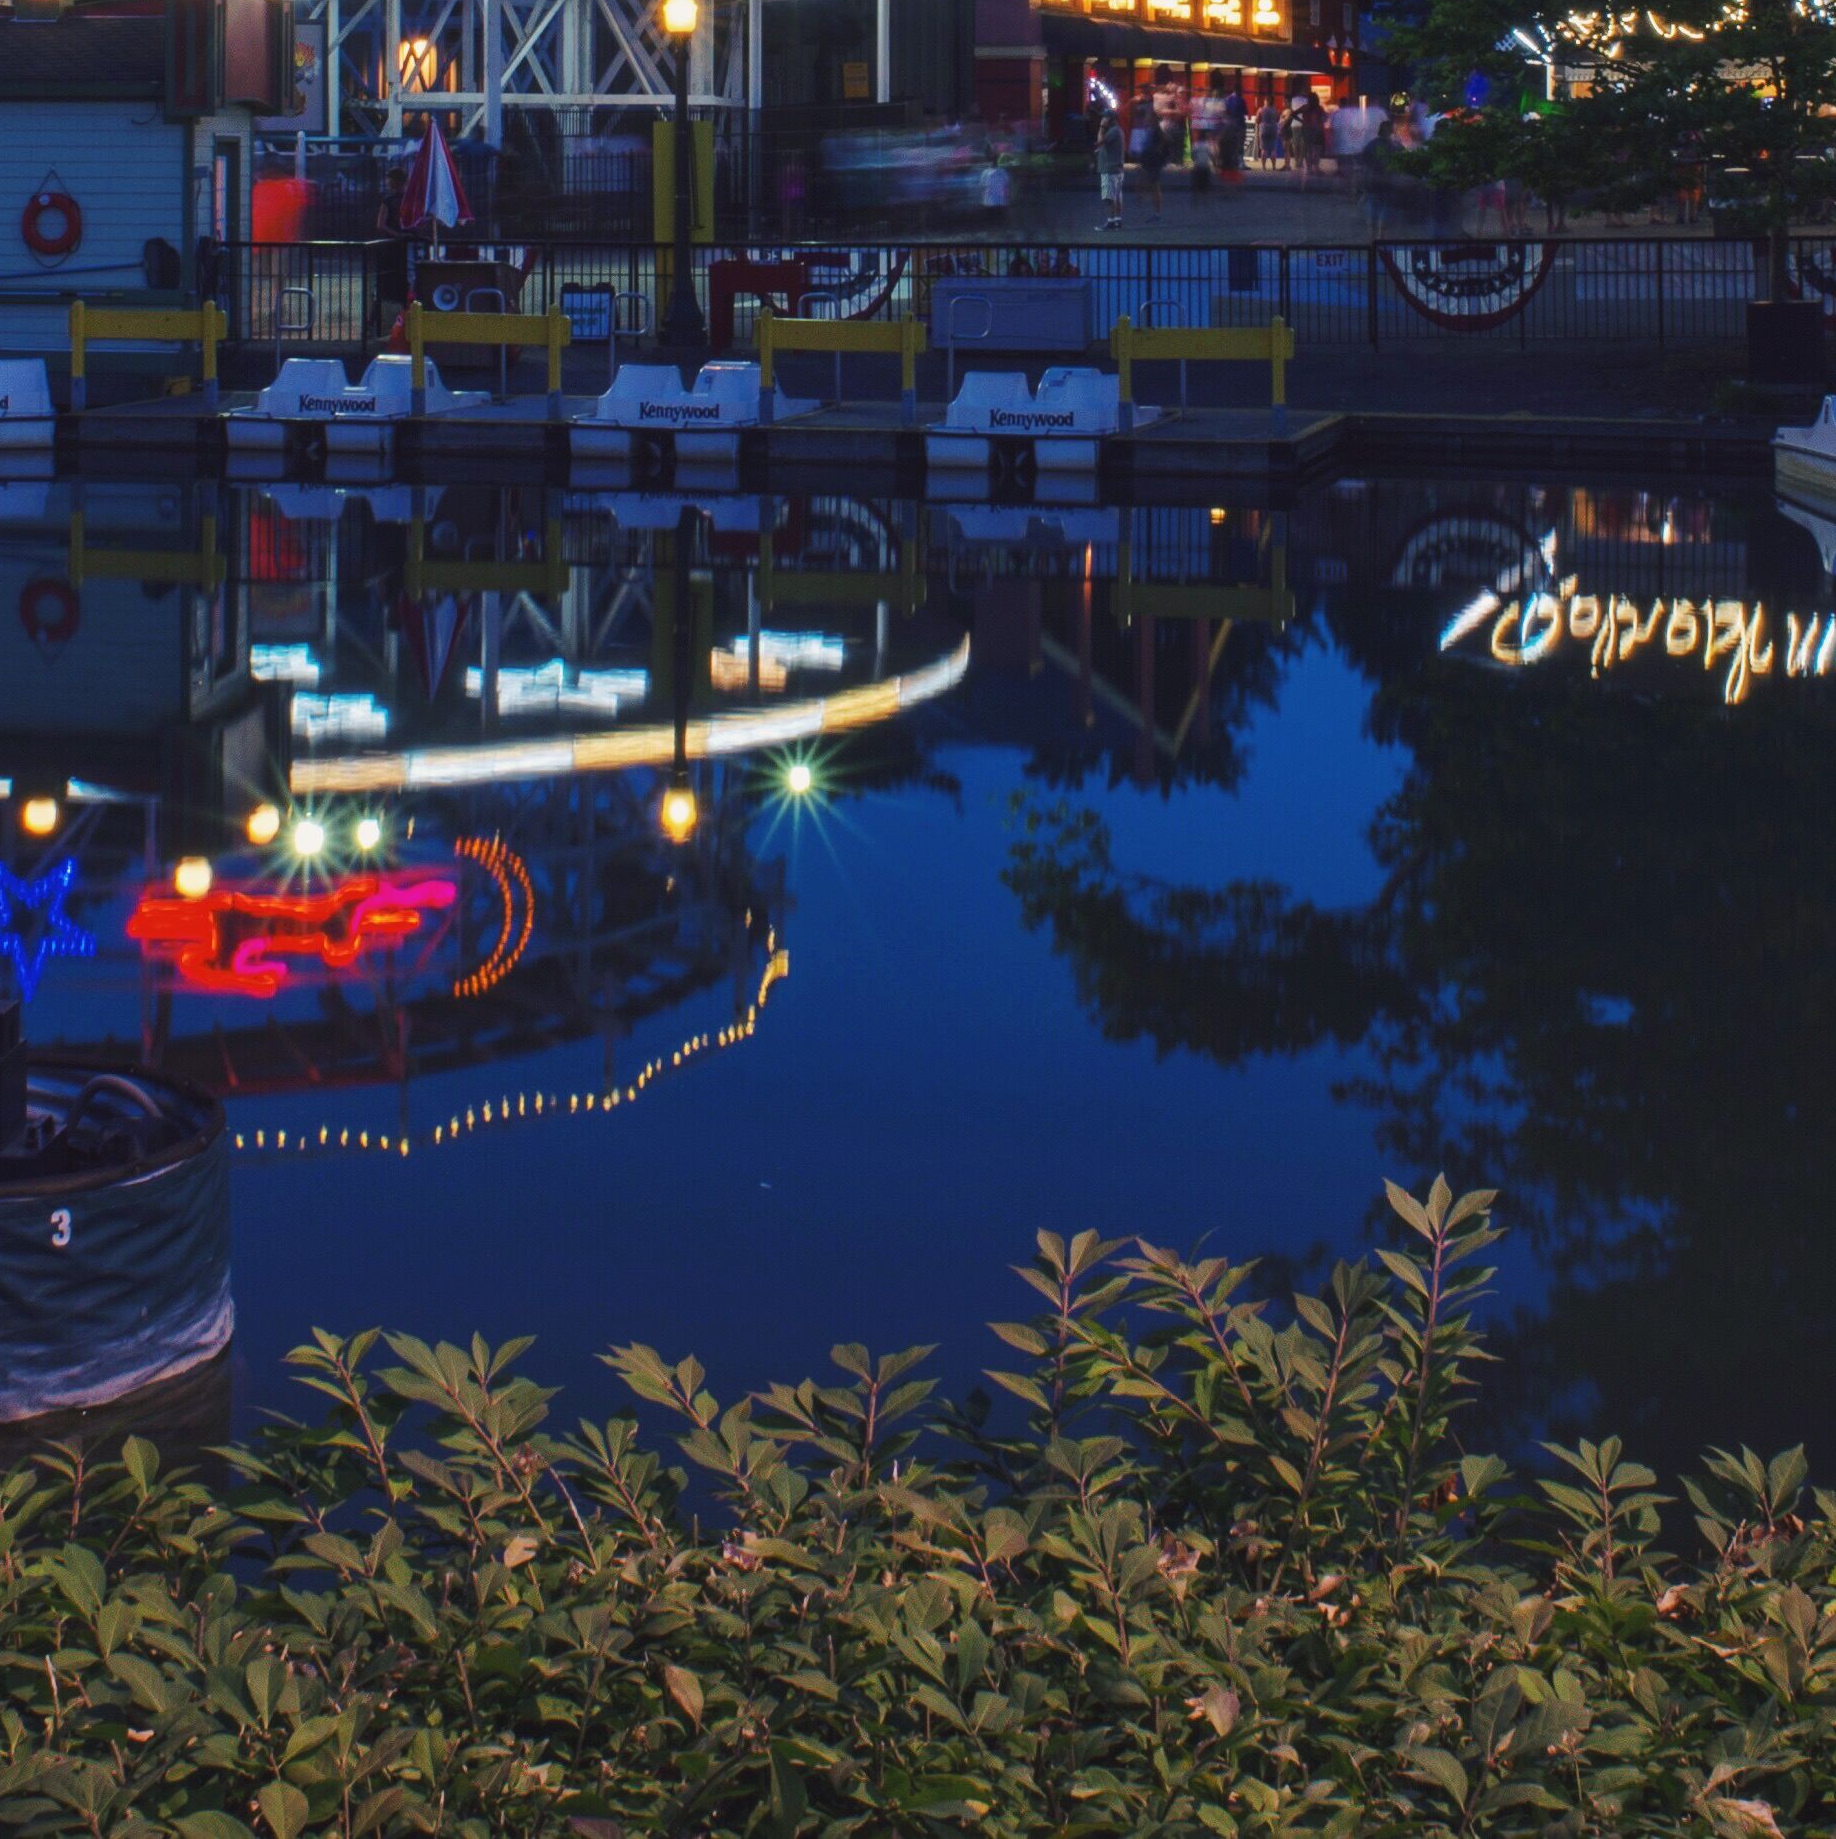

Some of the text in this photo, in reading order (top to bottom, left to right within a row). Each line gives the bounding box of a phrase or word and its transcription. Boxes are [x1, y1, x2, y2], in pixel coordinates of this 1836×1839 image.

[1316, 253, 1345, 267] EXIT
[299, 393, 375, 416] Kennywood
[639, 401, 720, 422] Kennywood
[990, 409, 1074, 429] Kennywood
[51, 1208, 71, 1247] 3
